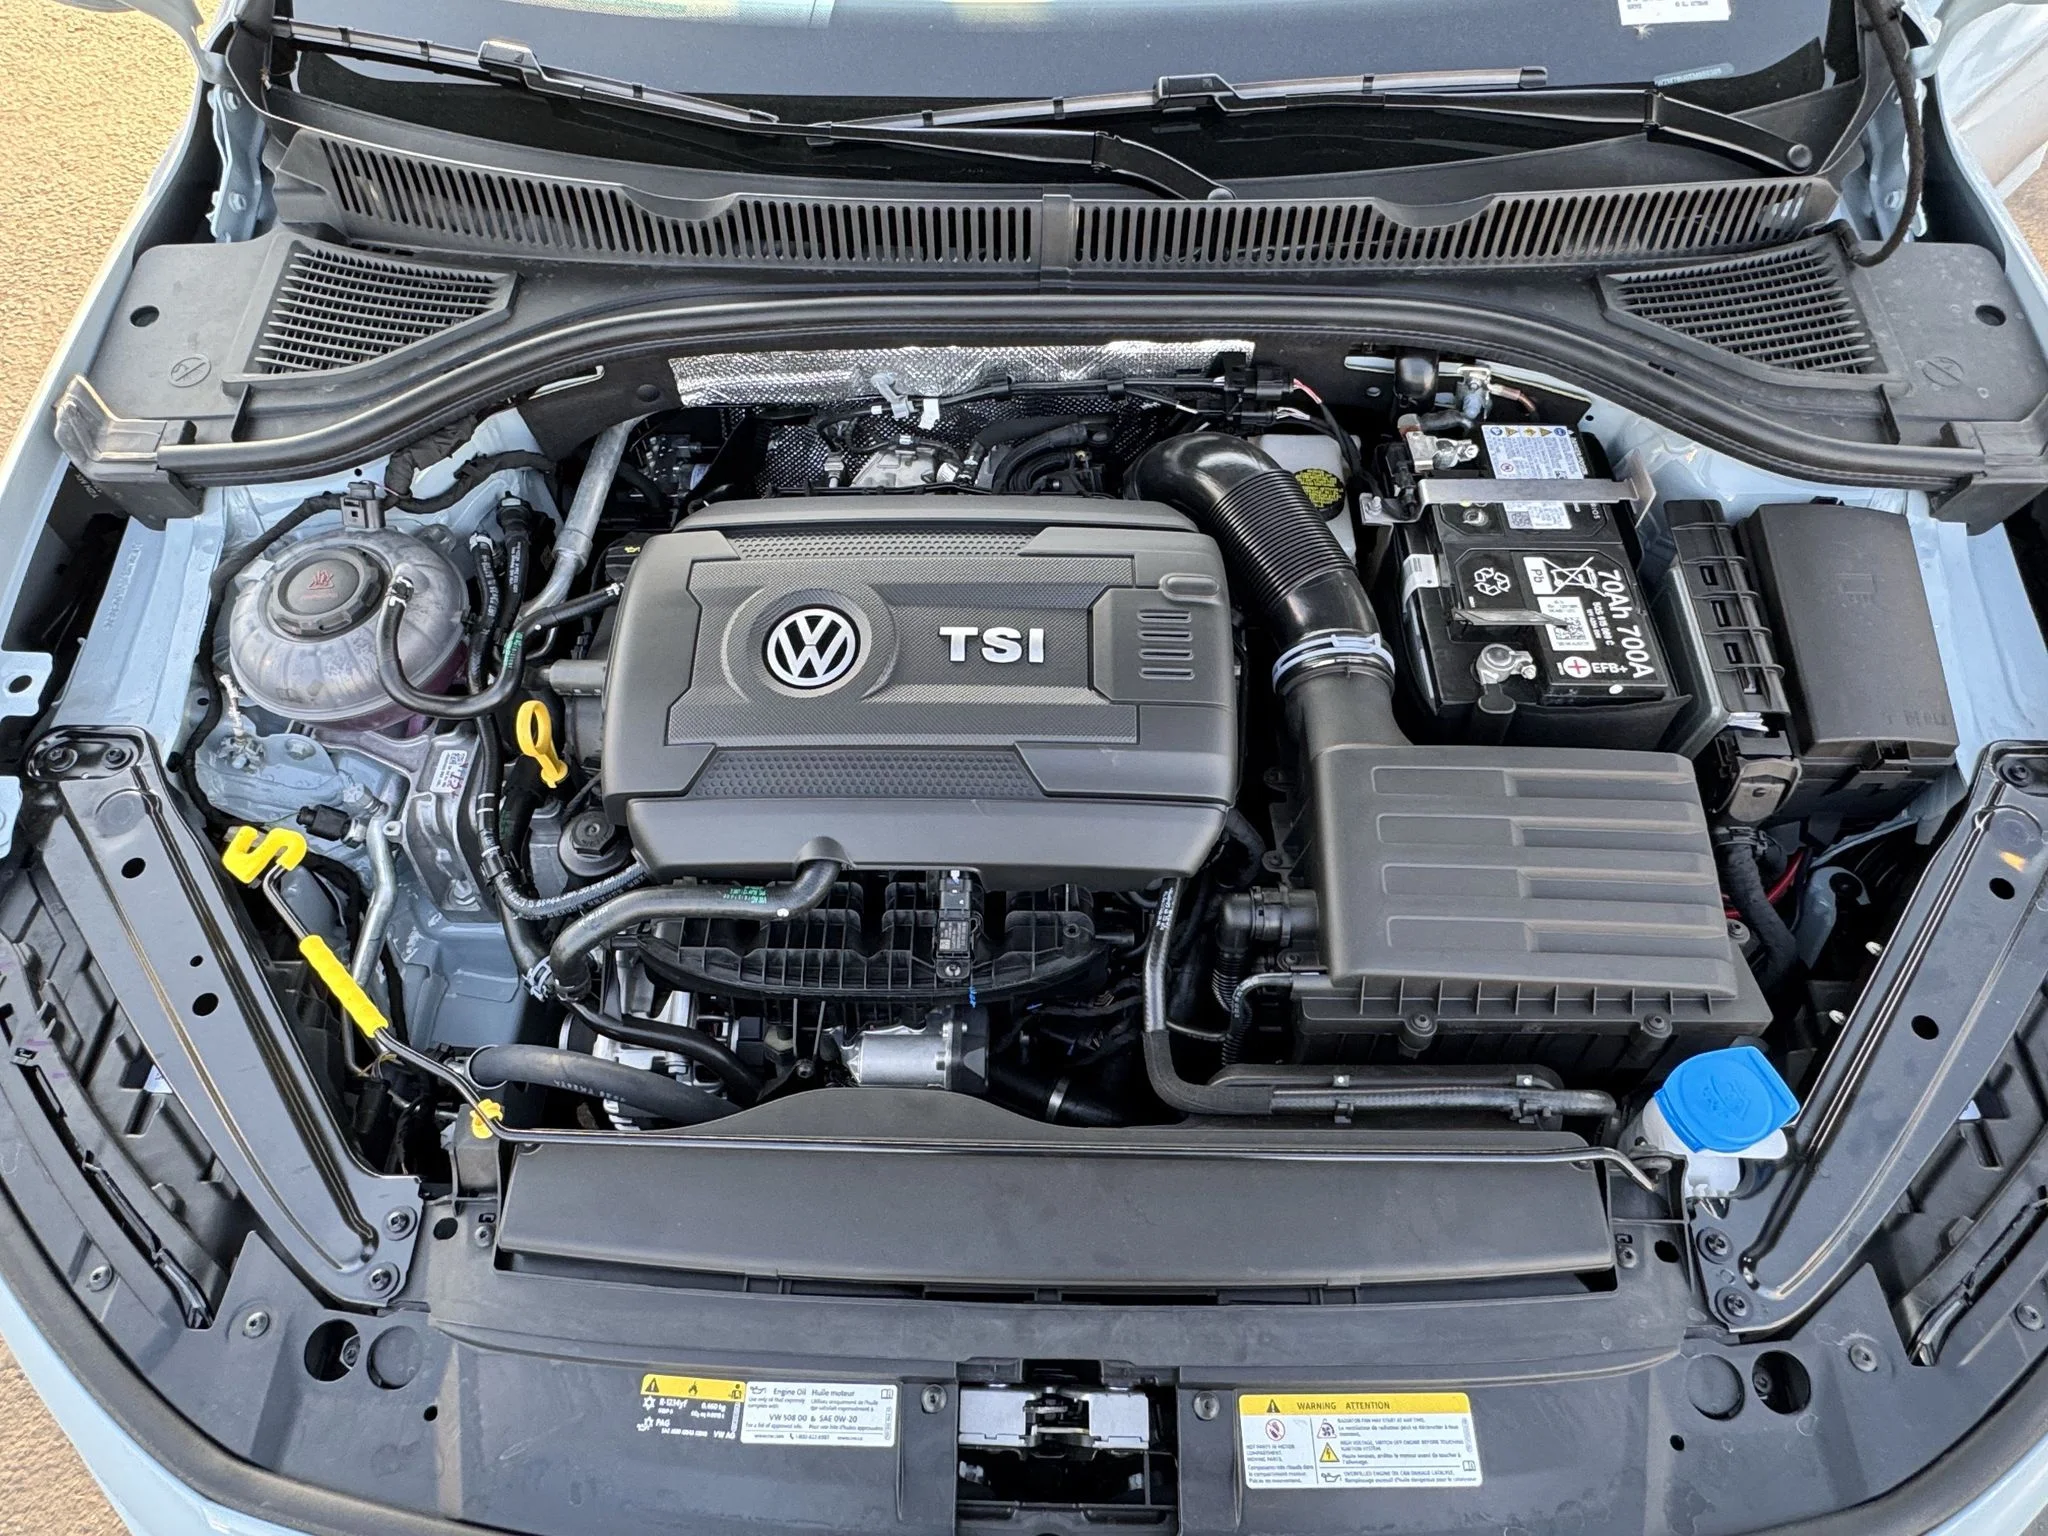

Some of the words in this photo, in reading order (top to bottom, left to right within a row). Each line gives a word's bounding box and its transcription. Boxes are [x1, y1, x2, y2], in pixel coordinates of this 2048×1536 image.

[1531, 568, 1543, 583] Pb
[1597, 570, 1633, 619] 70Ah
[1616, 625, 1655, 679] 700A
[938, 626, 1044, 664] TSI
[1591, 662, 1628, 673] EFB+
[773, 1388, 795, 1397] Engine
[812, 1388, 829, 1396] Huile
[1297, 1402, 1337, 1410] WARNING
[1345, 1401, 1390, 1410] ATTENTION
[797, 1414, 807, 1422] 00
[655, 1419, 671, 1427] PAG
[713, 1430, 725, 1438] VW
